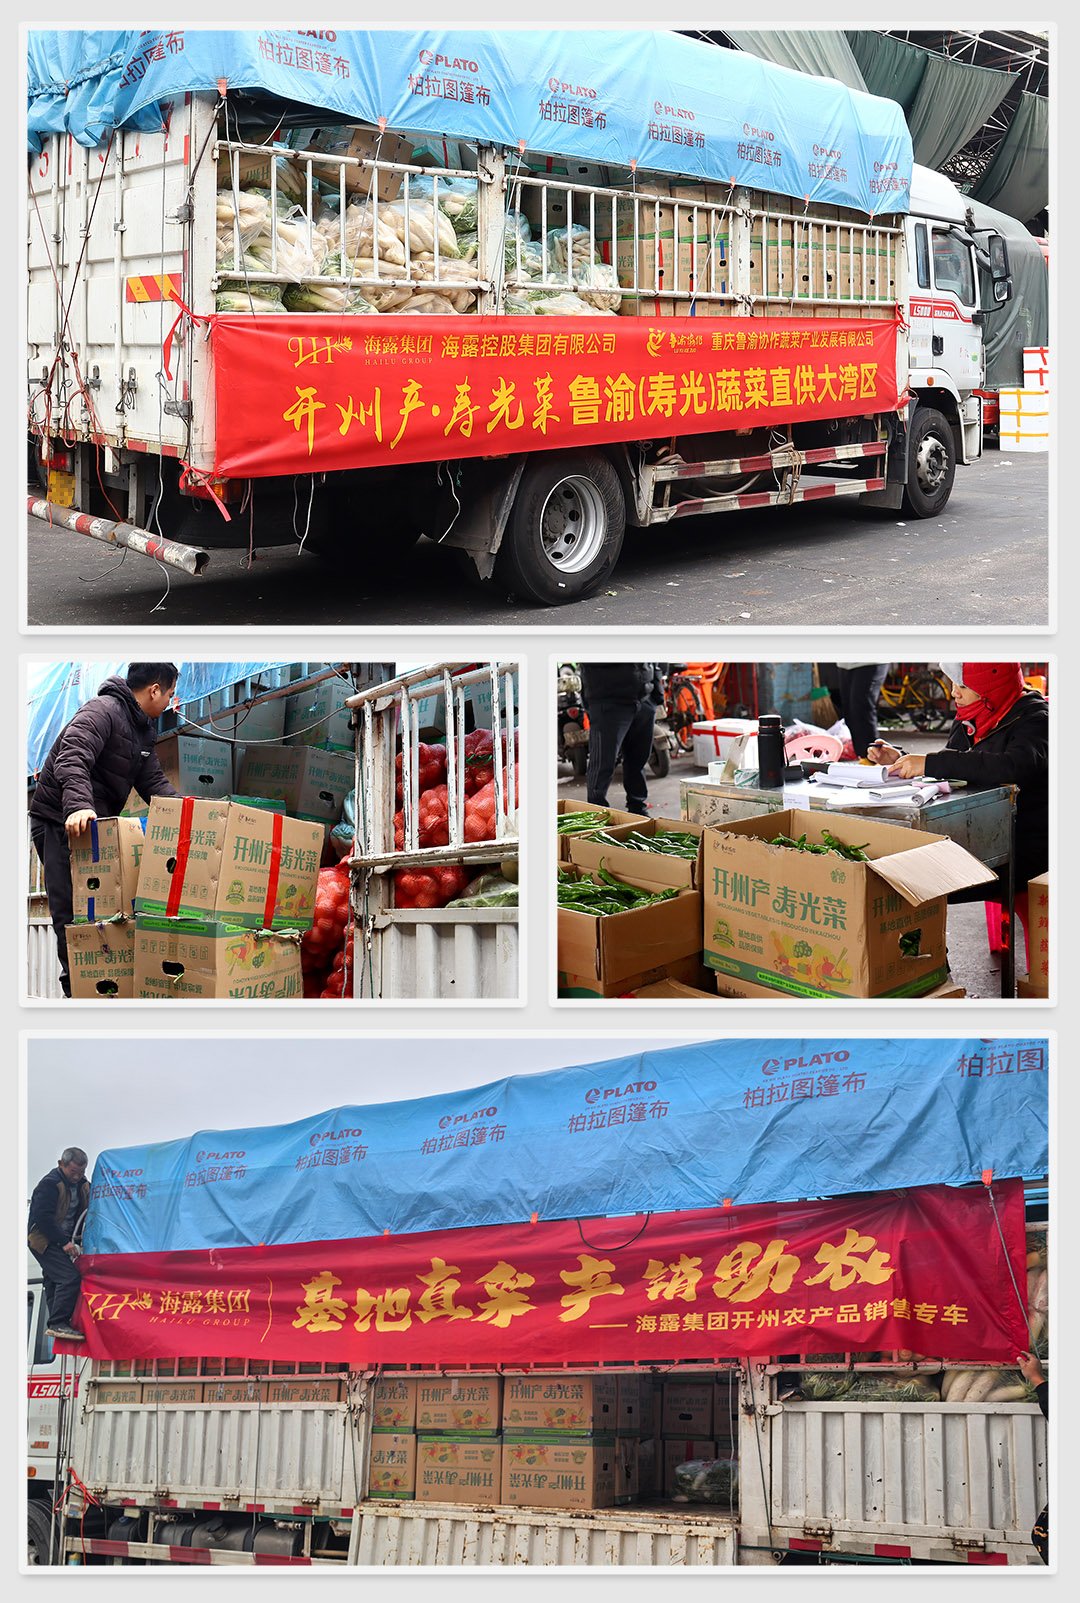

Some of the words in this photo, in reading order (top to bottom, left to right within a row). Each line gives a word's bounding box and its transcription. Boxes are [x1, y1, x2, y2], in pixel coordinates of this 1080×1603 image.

[258, 36, 350, 79] 柏拉图篷布
[435, 54, 479, 73] PLATO
[408, 73, 491, 107] 柏拉图篷布
[561, 83, 597, 99] PLATO
[539, 100, 607, 130] 柏拉图篷布
[664, 105, 696, 121] PLATO
[648, 121, 705, 149] 柏拉图篷布
[751, 127, 775, 141] PLATO
[737, 142, 782, 167] 柏拉图篷布
[364, 335, 433, 355] 海露集团
[441, 333, 616, 359] 海露控股集团有限公司
[711, 330, 874, 352] 重庆鲁渝协作蔬菜产业发展有限公司
[365, 358, 397, 366] HAILU
[402, 357, 433, 365] GROUP
[784, 1050, 850, 1071] PLATO
[603, 1080, 658, 1100] PLATO
[742, 1071, 868, 1109] 柏拉图篷布
[454, 1106, 498, 1126] PLATO
[567, 1100, 671, 1135] 柏拉图篷布
[320, 1128, 363, 1141] PLATO
[421, 1124, 507, 1155] 柏拉图篷布
[206, 1150, 246, 1161] PLATO
[295, 1145, 368, 1172] 柏拉图篷布
[184, 1164, 247, 1188] 柏拉图篷布
[159, 1288, 250, 1316] 海露集团
[149, 1316, 197, 1325] HAILU
[203, 1318, 251, 1328] GROUP
